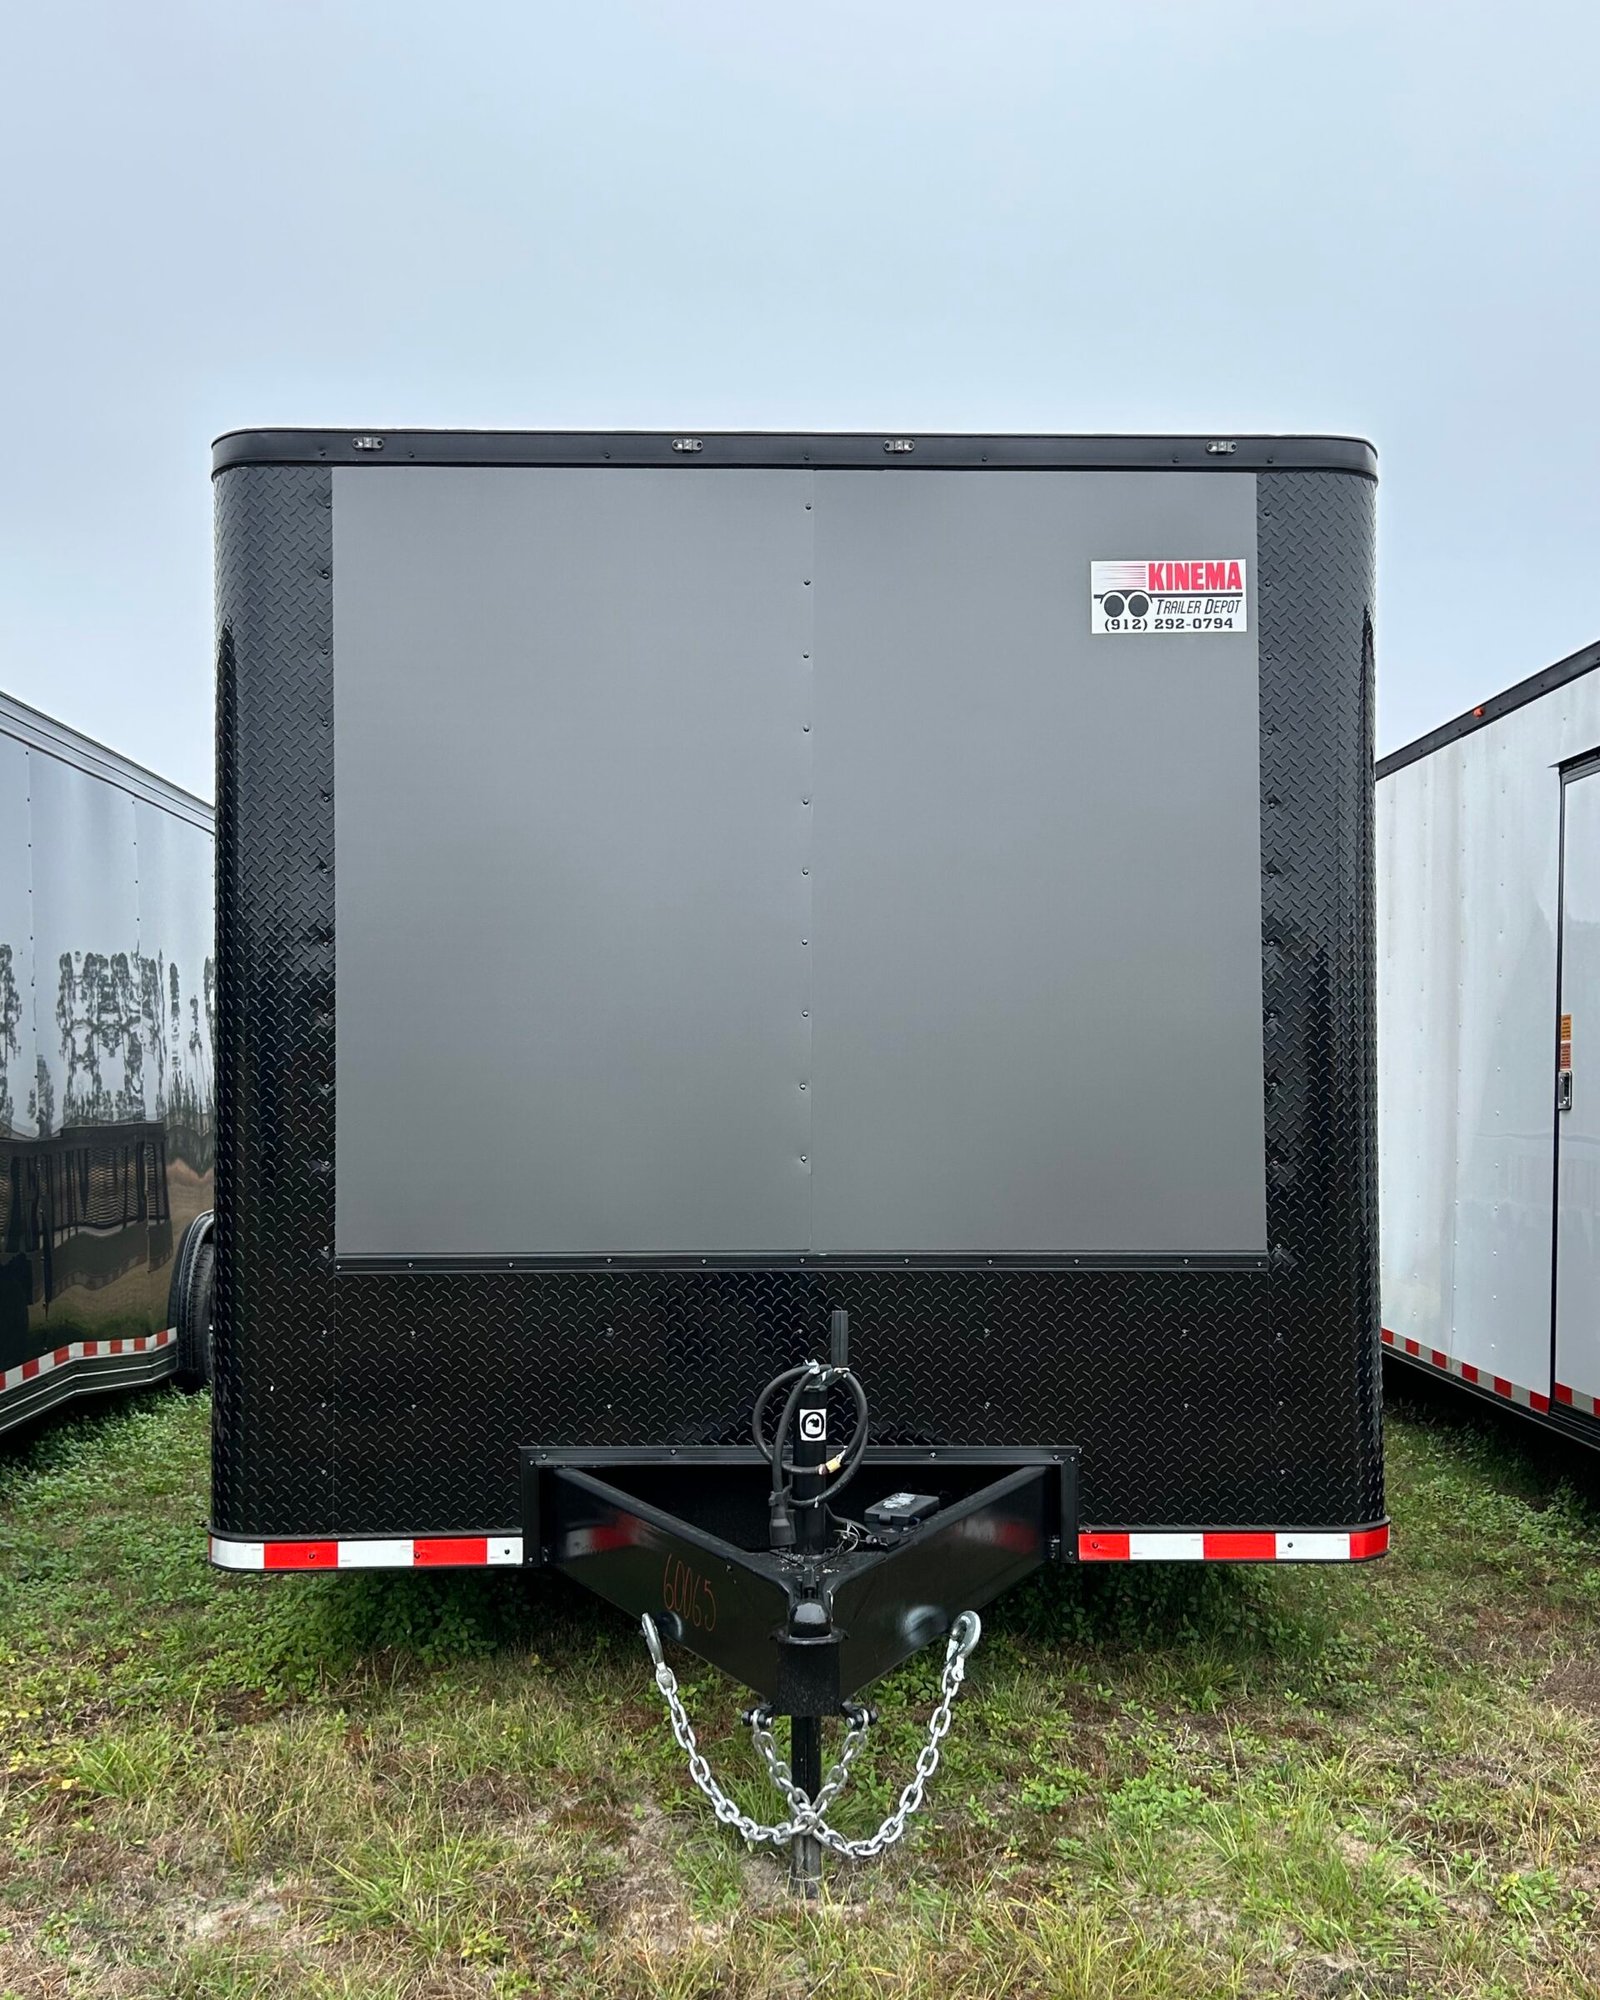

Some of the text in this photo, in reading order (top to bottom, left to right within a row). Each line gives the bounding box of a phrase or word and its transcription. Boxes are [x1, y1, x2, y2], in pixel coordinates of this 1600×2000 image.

[1148, 562, 1242, 591] KINEMA
[1156, 599, 1241, 615] TRAILER DEPOT
[1104, 618, 1233, 632] (912) 292-0794
[663, 1553, 716, 1632] 60065
